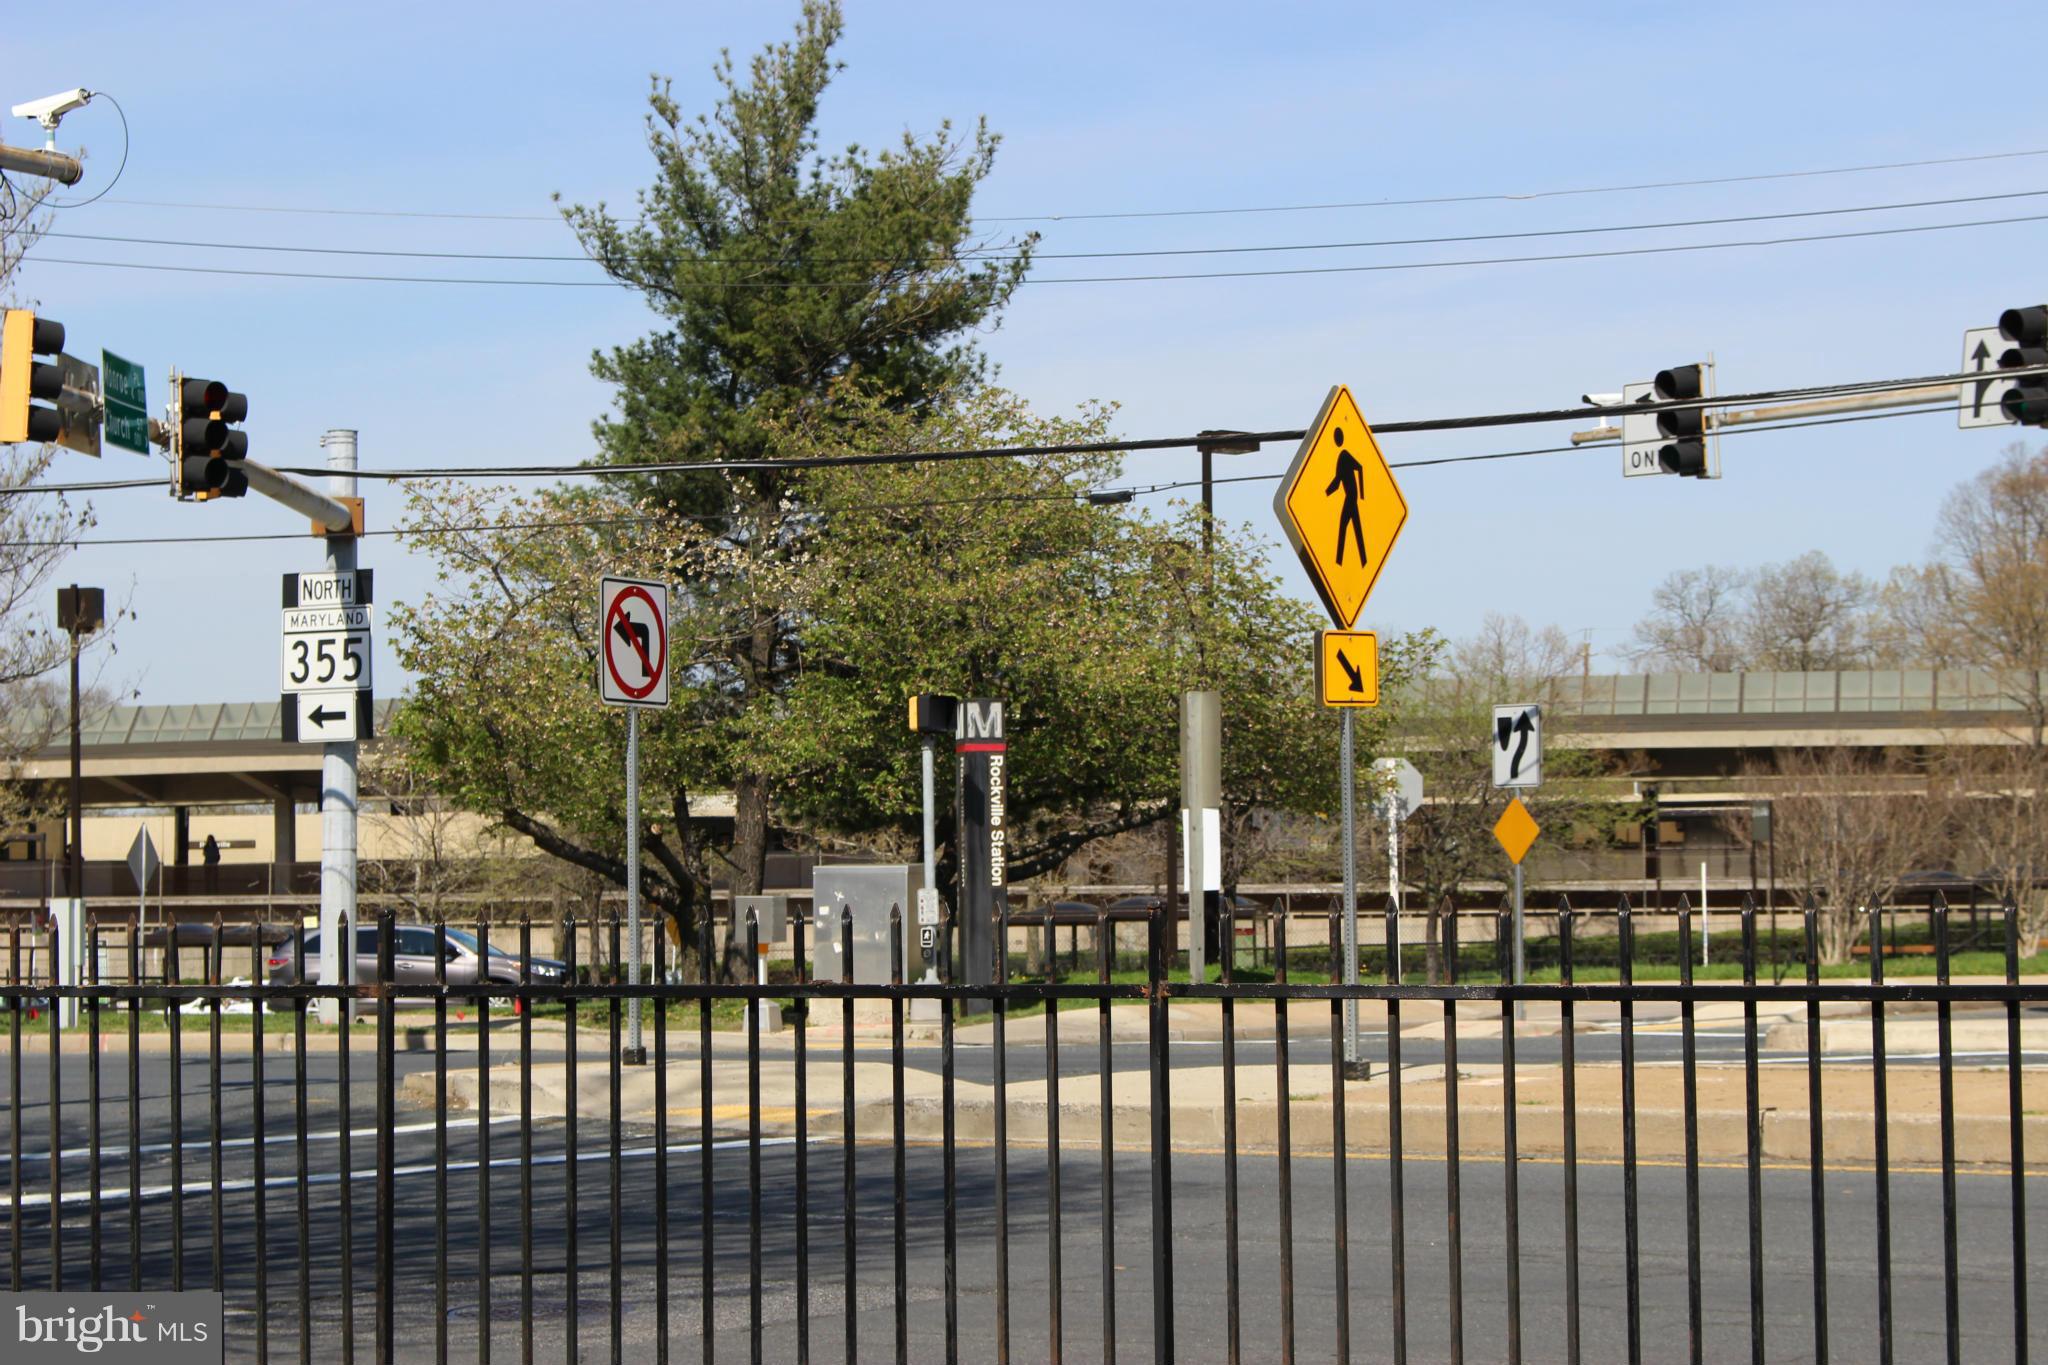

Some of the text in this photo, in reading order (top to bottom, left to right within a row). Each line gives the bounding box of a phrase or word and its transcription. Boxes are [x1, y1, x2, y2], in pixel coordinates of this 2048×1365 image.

[1631, 449, 1656, 468] ON
[303, 578, 351, 600] NORTH
[290, 611, 364, 627] MARYLAND
[290, 637, 362, 684] 355
[990, 755, 1004, 886] Rockville Station
